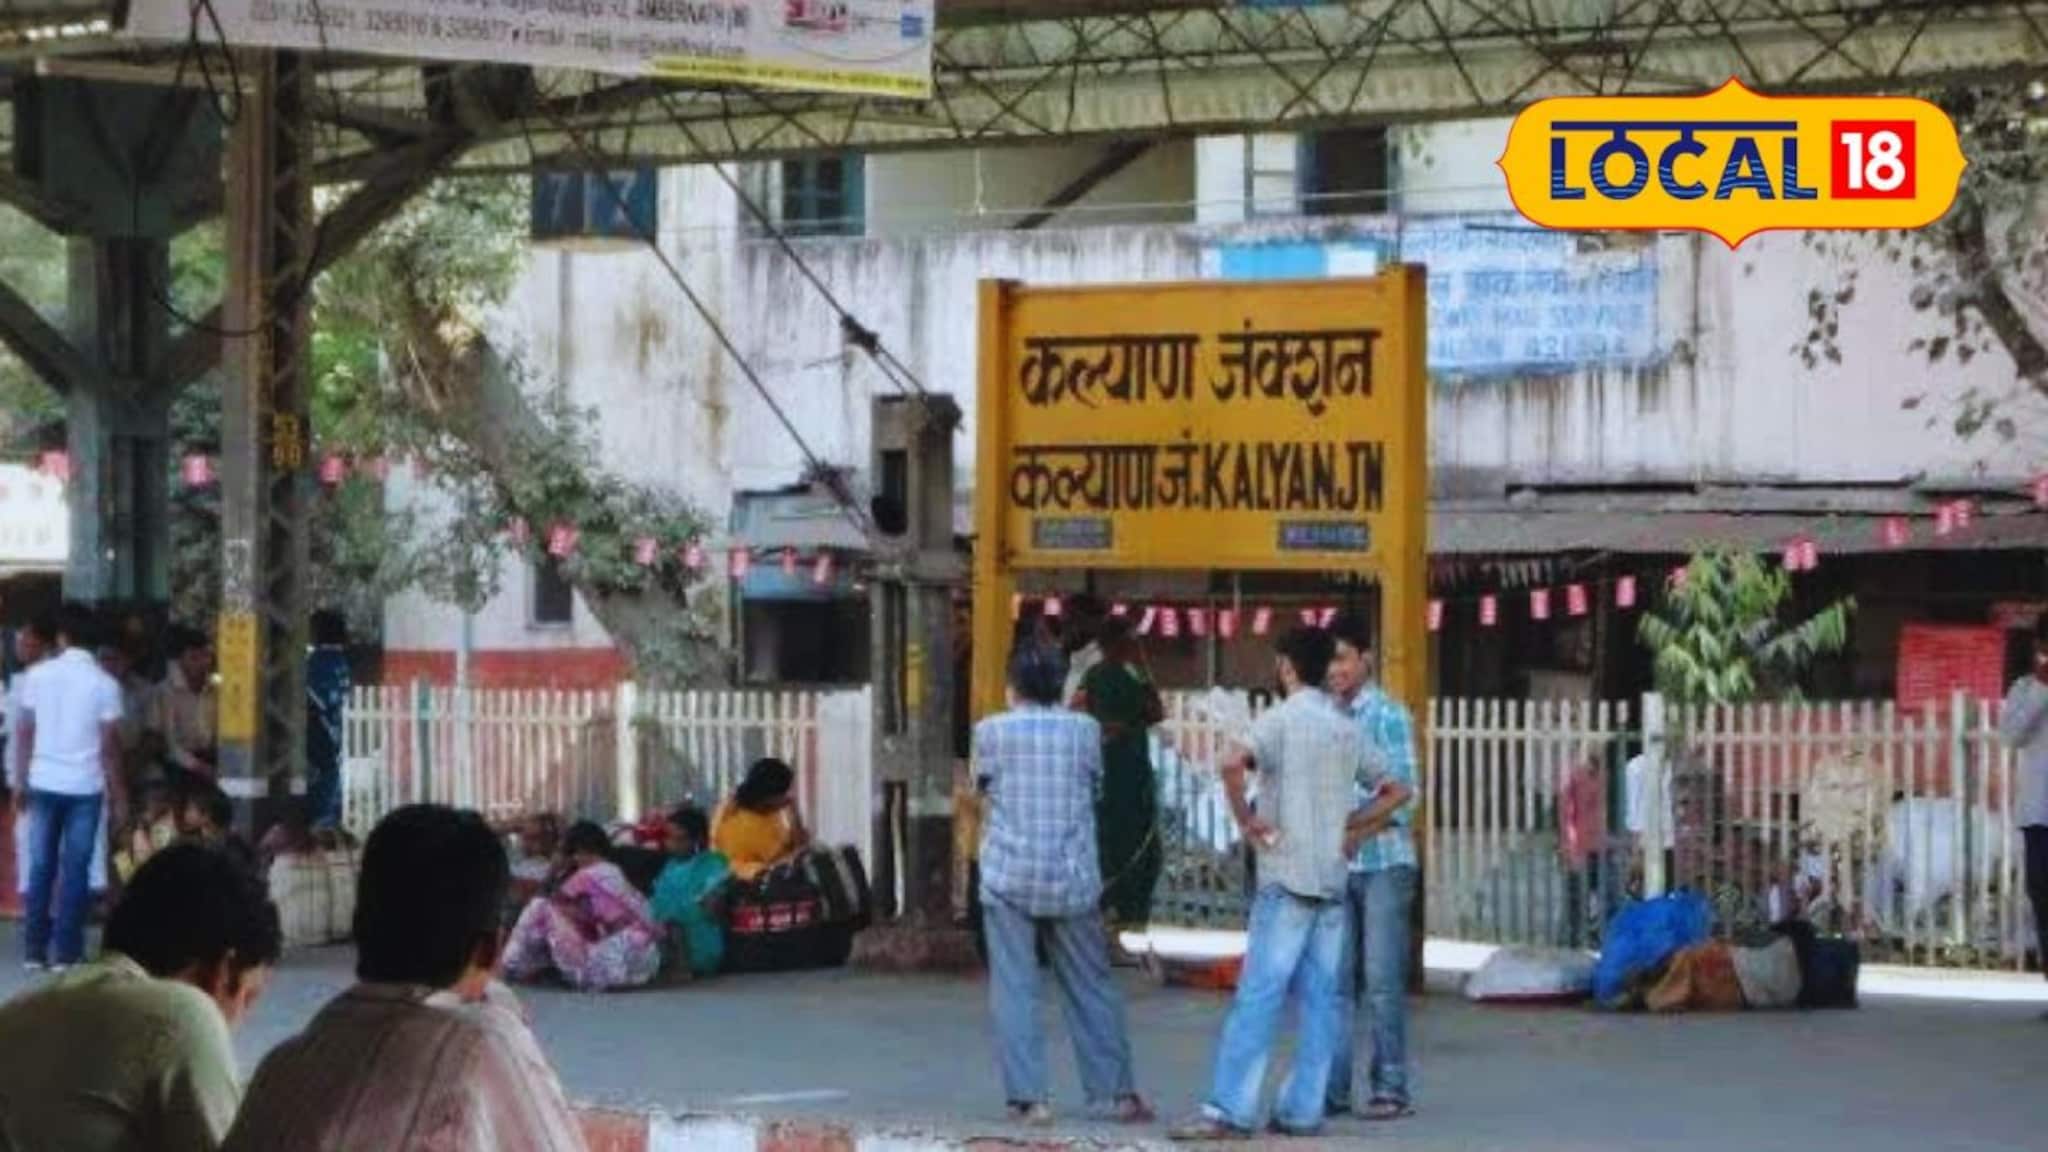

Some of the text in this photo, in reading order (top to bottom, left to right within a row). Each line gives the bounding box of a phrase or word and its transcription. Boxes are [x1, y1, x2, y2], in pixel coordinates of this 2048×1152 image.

[1021, 319, 1382, 417] कल्याण जंक्शन
[1011, 444, 1157, 511] कल्याण
